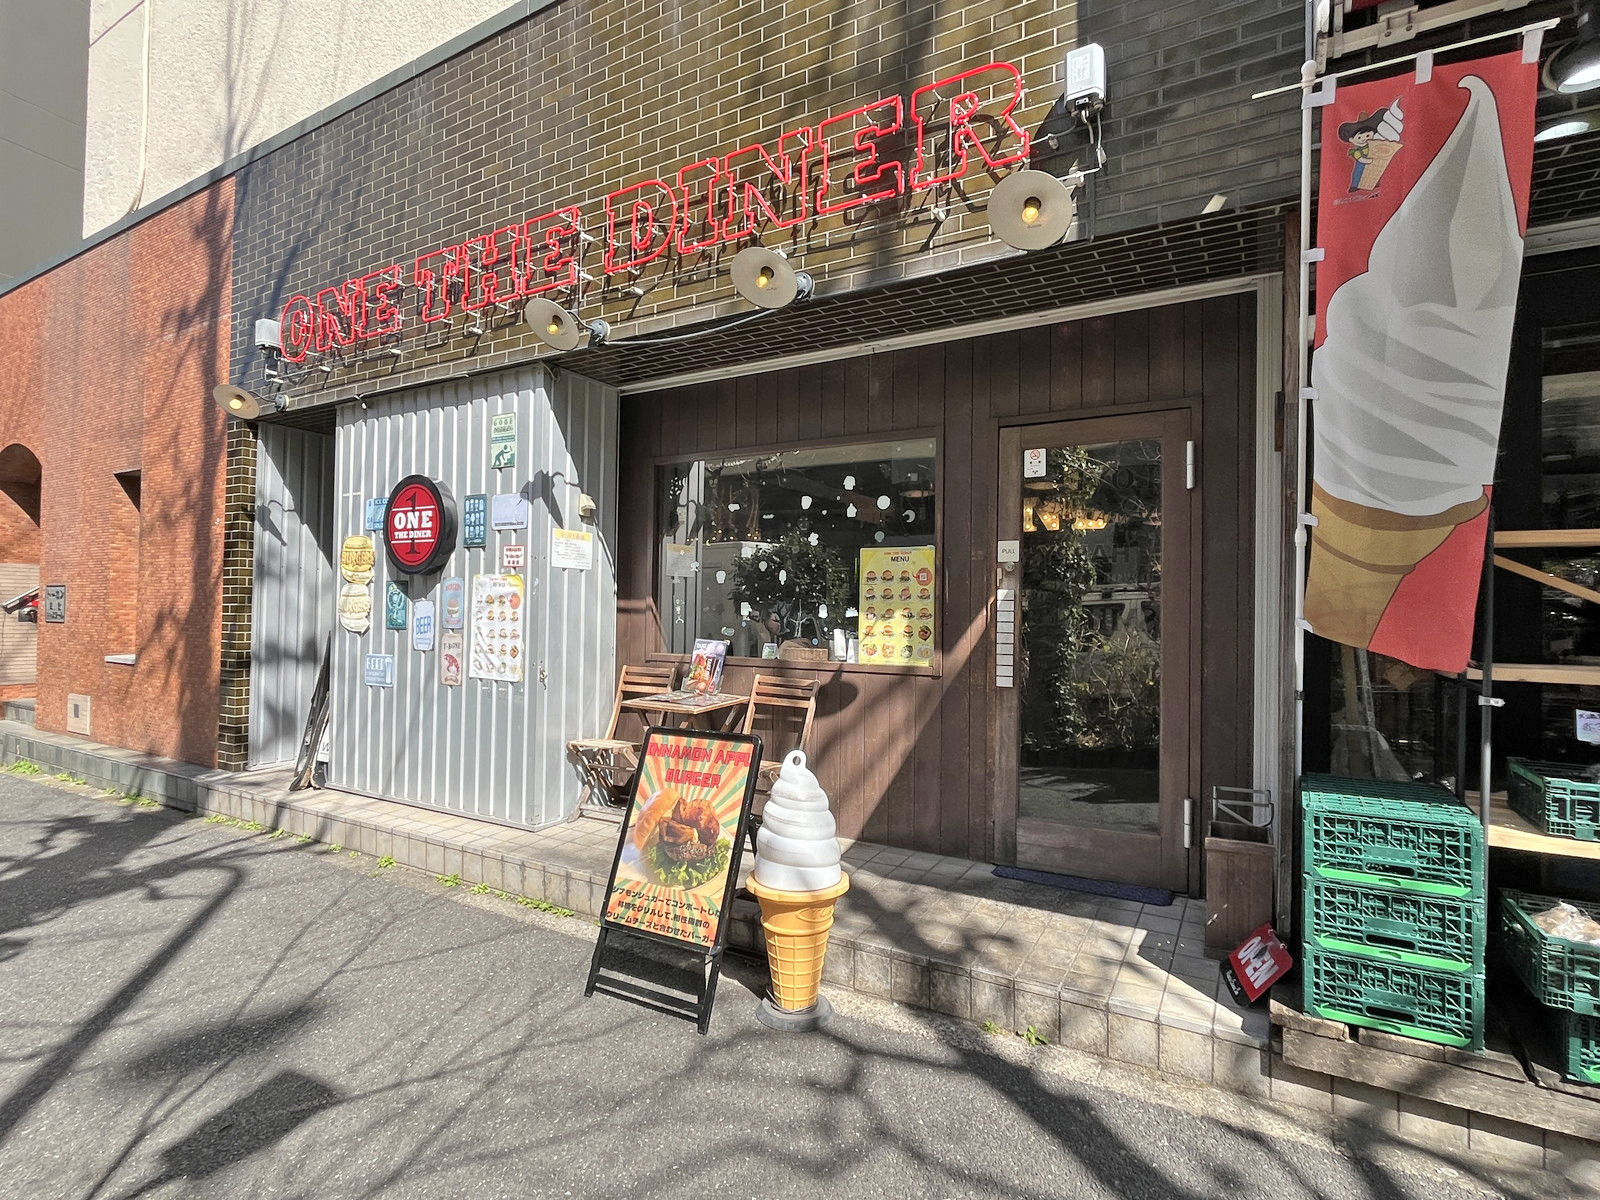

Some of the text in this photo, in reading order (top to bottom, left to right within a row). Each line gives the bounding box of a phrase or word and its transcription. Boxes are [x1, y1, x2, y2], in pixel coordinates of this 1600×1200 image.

[279, 61, 1030, 363] ONE THE DINER
[393, 510, 433, 530] ONE
[394, 529, 432, 539] THE DINER
[415, 615, 432, 635] BEER
[647, 742, 751, 768] INNAMON APPL
[665, 768, 722, 789] BURGER
[1237, 936, 1280, 990] OPEN
